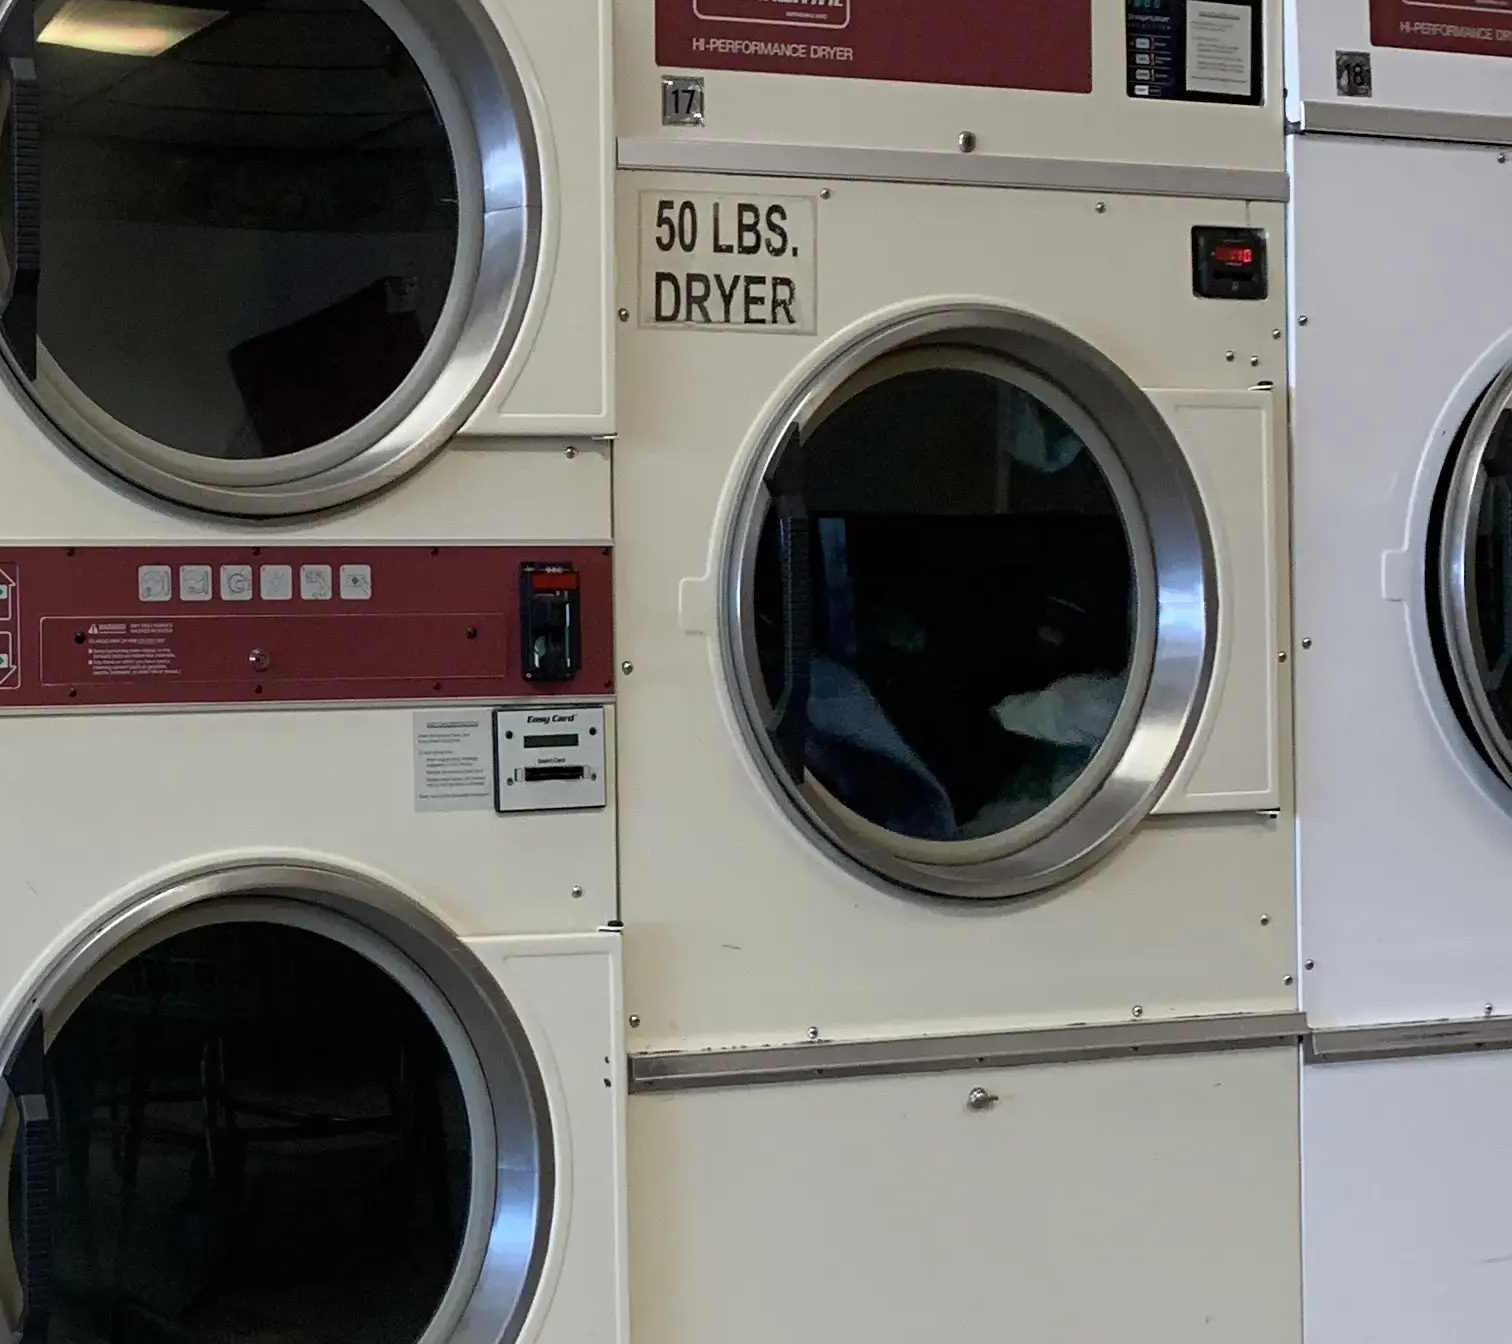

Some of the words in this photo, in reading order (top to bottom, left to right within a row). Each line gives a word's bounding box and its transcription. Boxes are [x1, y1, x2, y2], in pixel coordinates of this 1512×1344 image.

[1399, 20, 1494, 41] HI-PERFORMANCE
[692, 37, 807, 59] HI-PERFORMANCE
[810, 44, 854, 61] DRYER
[1345, 63, 1364, 87] 18
[671, 88, 696, 115] 17
[655, 199, 698, 253] 50
[712, 201, 799, 258] LBS.
[654, 271, 797, 325] DRYER
[551, 714, 575, 723] Card
